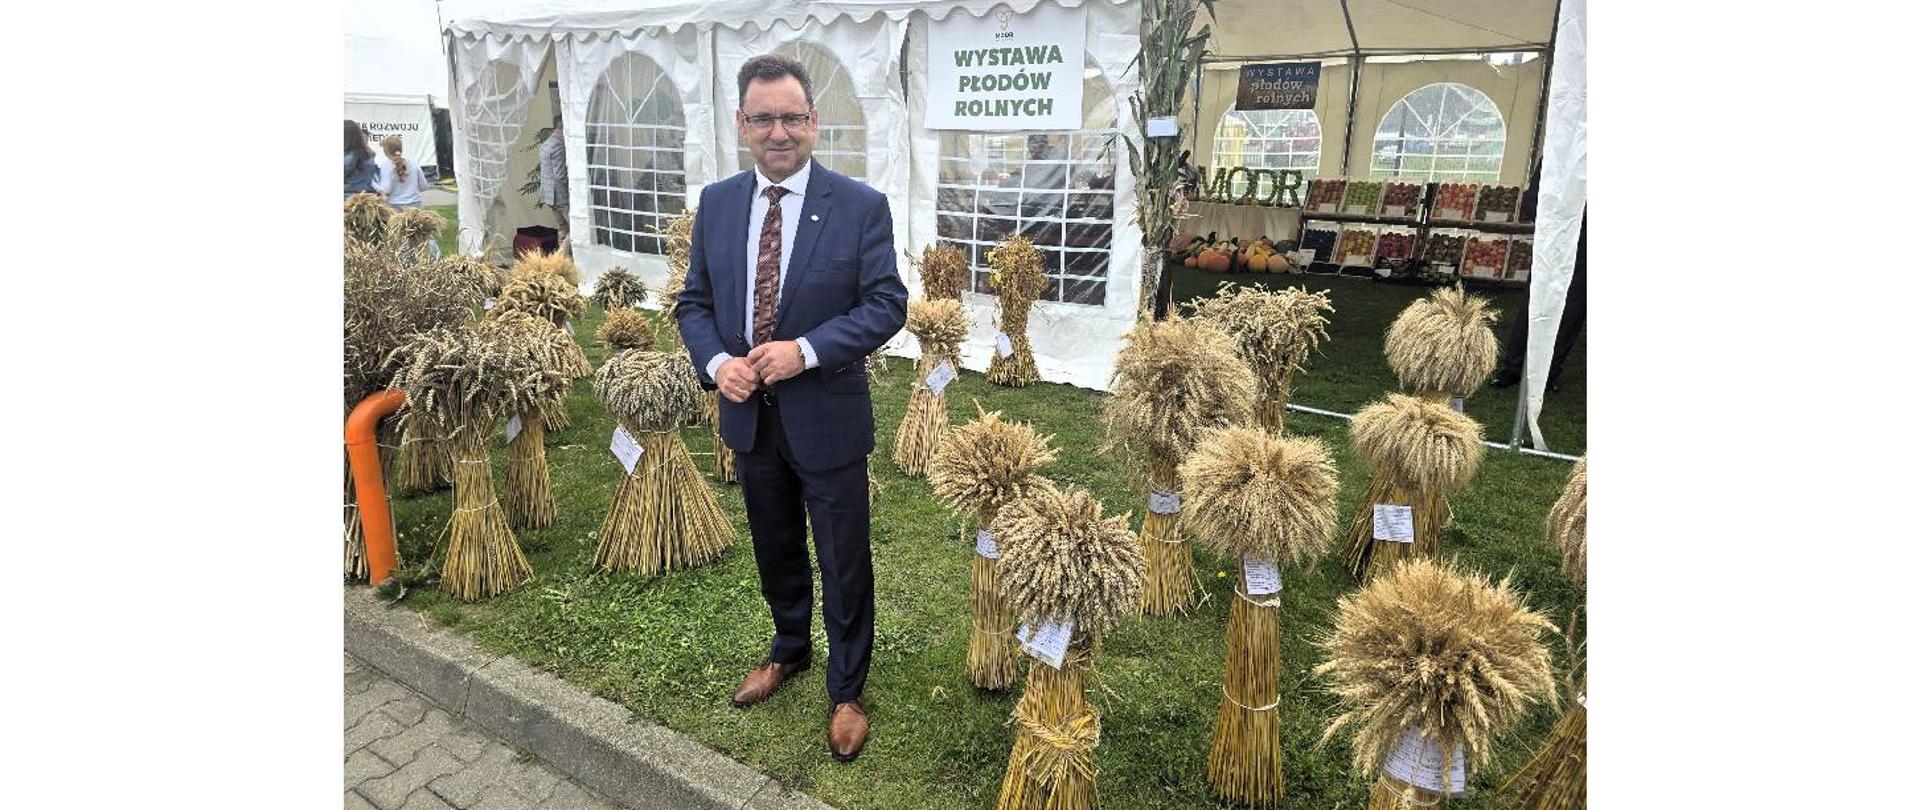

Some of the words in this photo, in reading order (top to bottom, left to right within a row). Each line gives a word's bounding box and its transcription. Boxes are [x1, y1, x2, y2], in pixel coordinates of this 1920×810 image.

[954, 45, 1064, 67] WYSTAWA
[959, 67, 1052, 93] PŁODÓW
[1247, 66, 1314, 77] WYSTAWA
[1250, 77, 1304, 94] płodów
[1256, 91, 1310, 105] rolnych
[954, 98, 1054, 117] ROLNYCH
[370, 122, 419, 131] ROZWOJU
[1197, 166, 1302, 208] MODR
